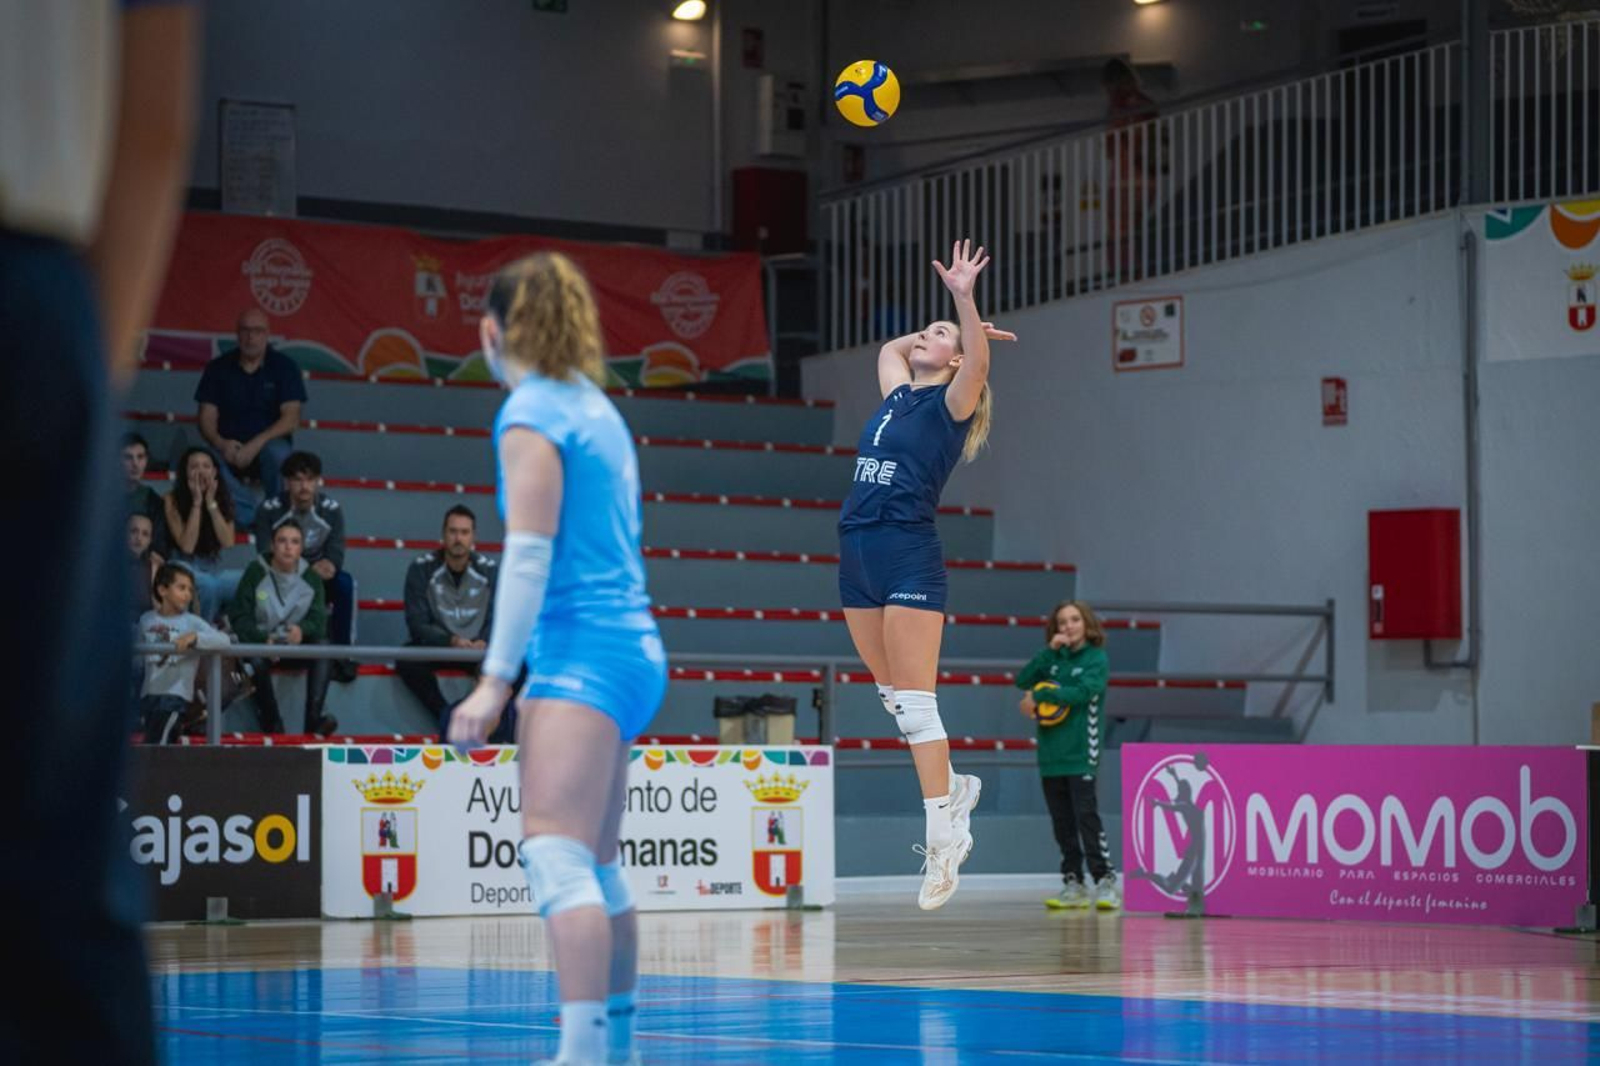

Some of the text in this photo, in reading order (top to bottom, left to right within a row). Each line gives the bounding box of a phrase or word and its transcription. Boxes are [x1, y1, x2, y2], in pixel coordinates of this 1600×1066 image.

[681, 777, 717, 813] de
[118, 794, 310, 885] ajasol
[1247, 867, 1577, 887] MOBILIARIO PARA ESPACIOS COMERCIALES
[471, 882, 536, 908] Deport
[1329, 889, 1488, 914] Con el deporte femenino
